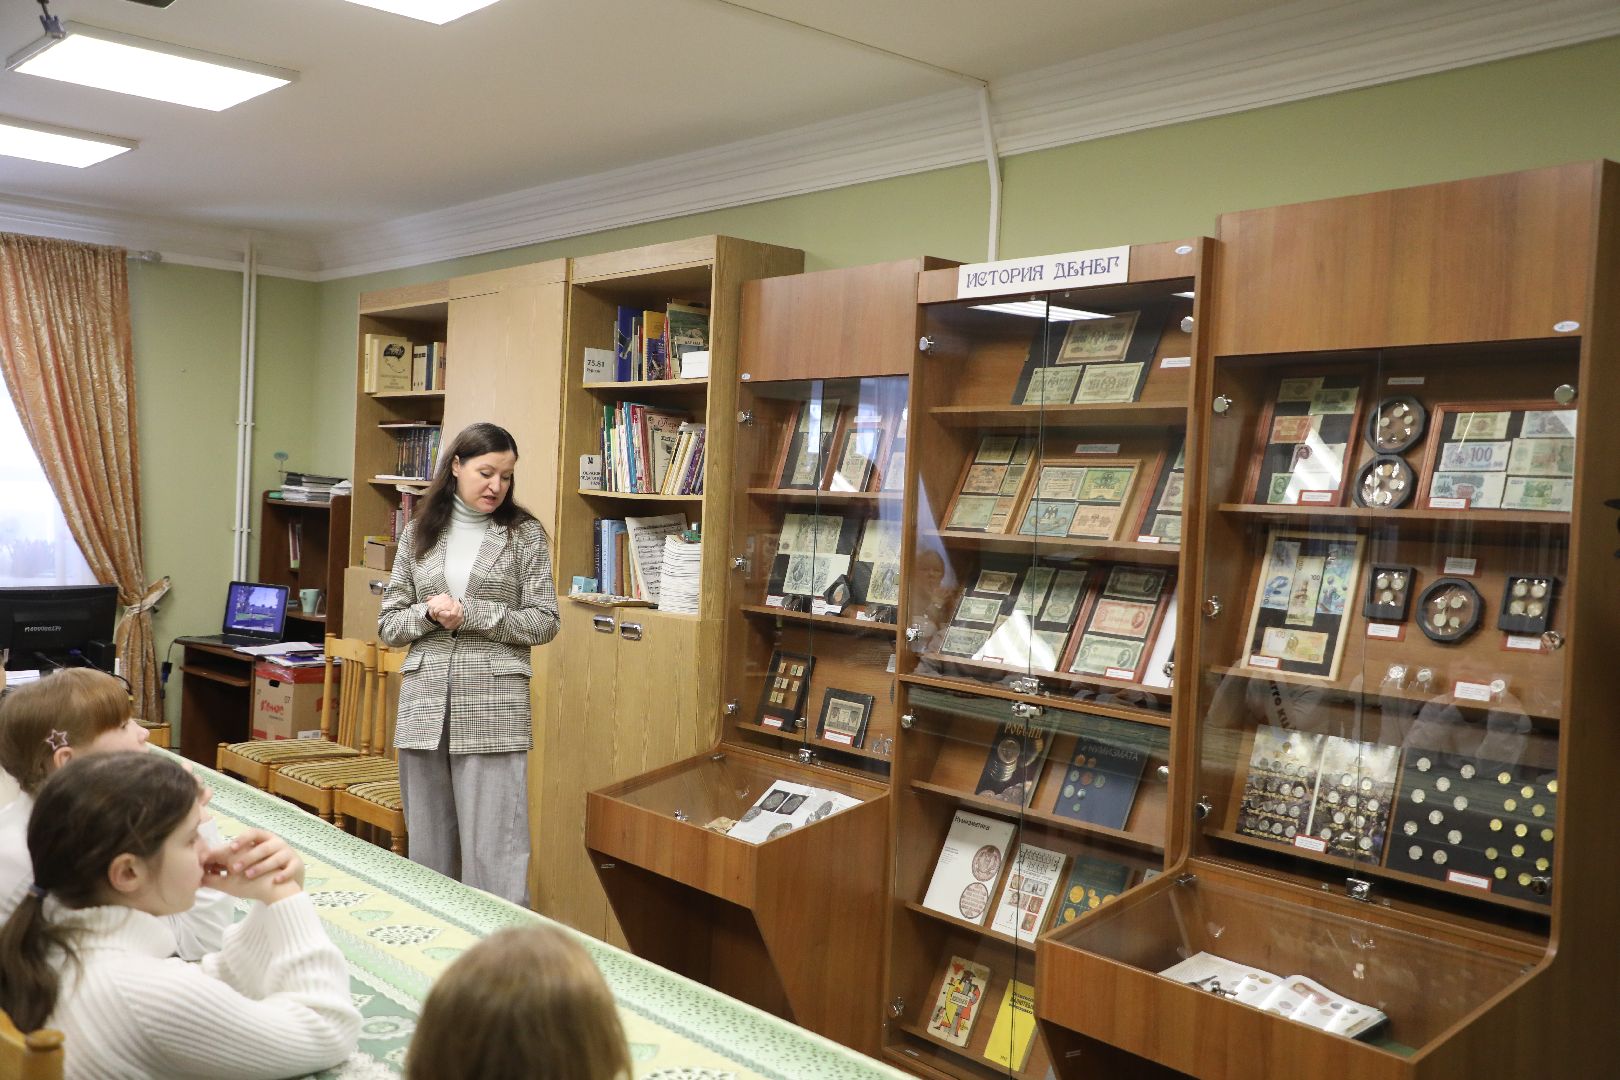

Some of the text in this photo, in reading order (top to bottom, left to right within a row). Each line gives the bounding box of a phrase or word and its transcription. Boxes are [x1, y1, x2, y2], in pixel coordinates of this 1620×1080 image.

[967, 256, 1120, 289] ИСТОРИЯ ДЕНЕГ
[1470, 446, 1493, 462] 100
